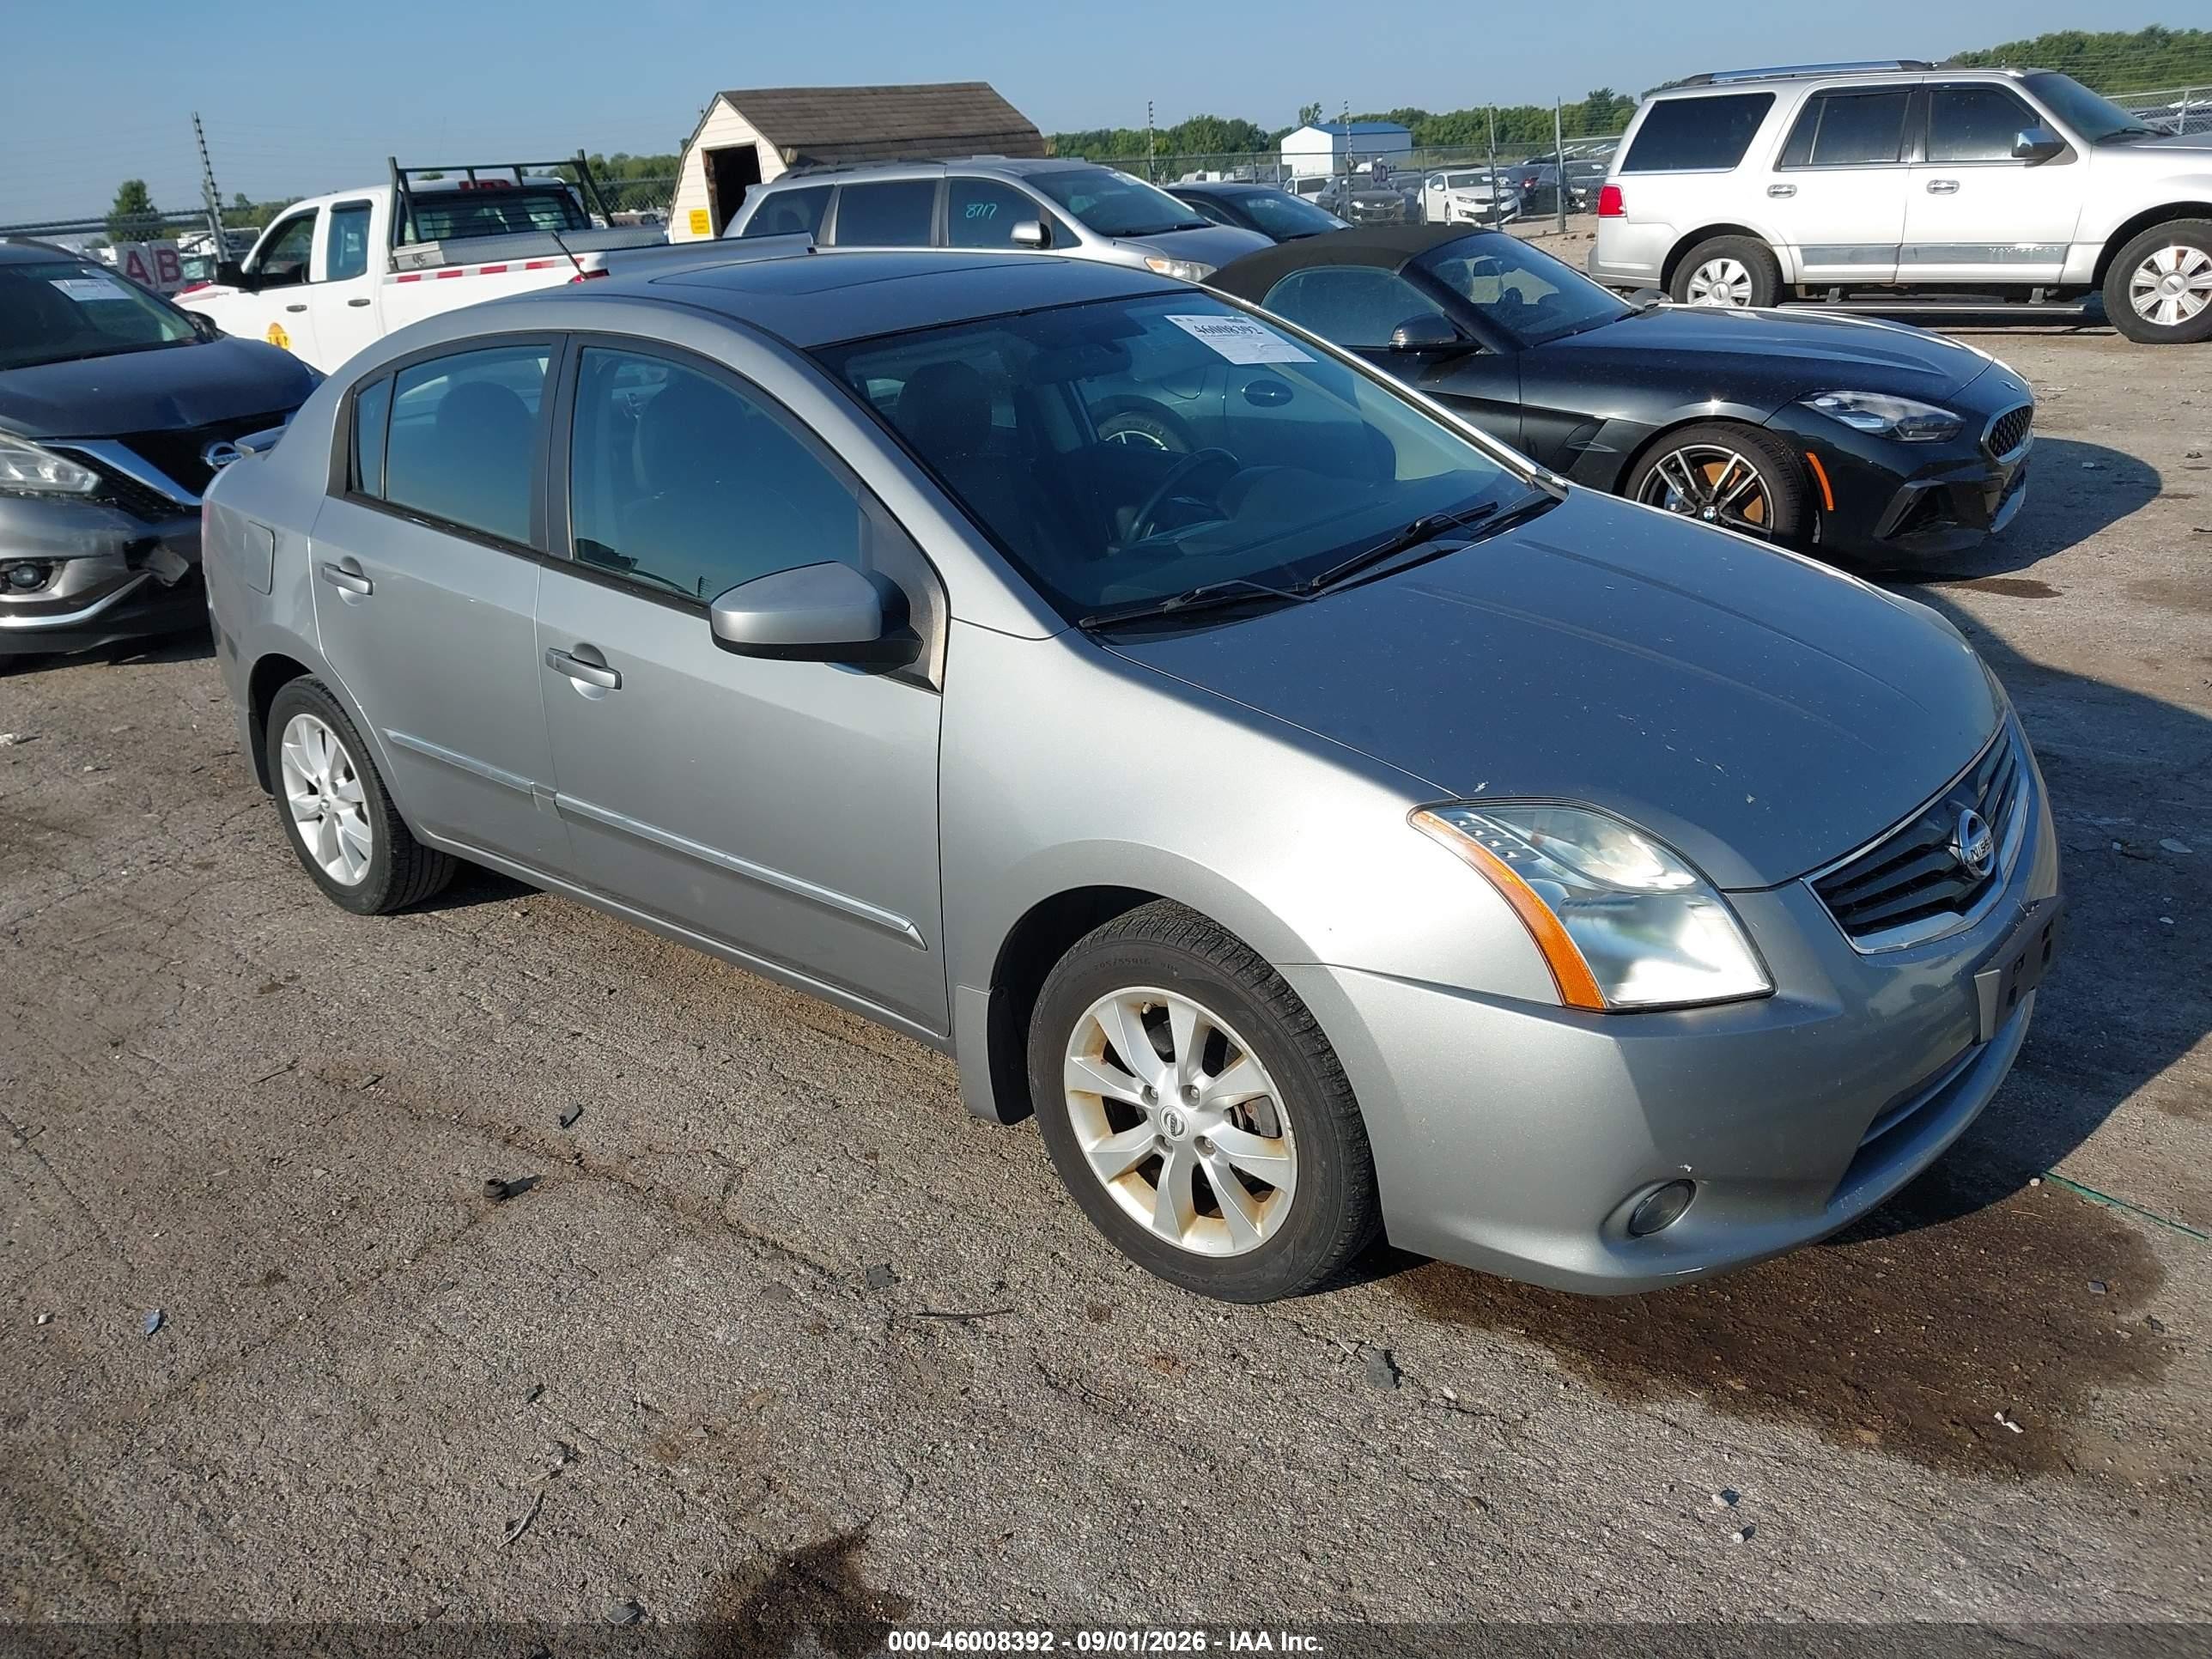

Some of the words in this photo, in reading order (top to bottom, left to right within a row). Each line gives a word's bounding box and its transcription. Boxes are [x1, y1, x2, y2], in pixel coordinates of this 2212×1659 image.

[1373, 164, 1388, 182] CD
[966, 204, 997, 220] 8717
[1194, 325, 1263, 335] 46008392
